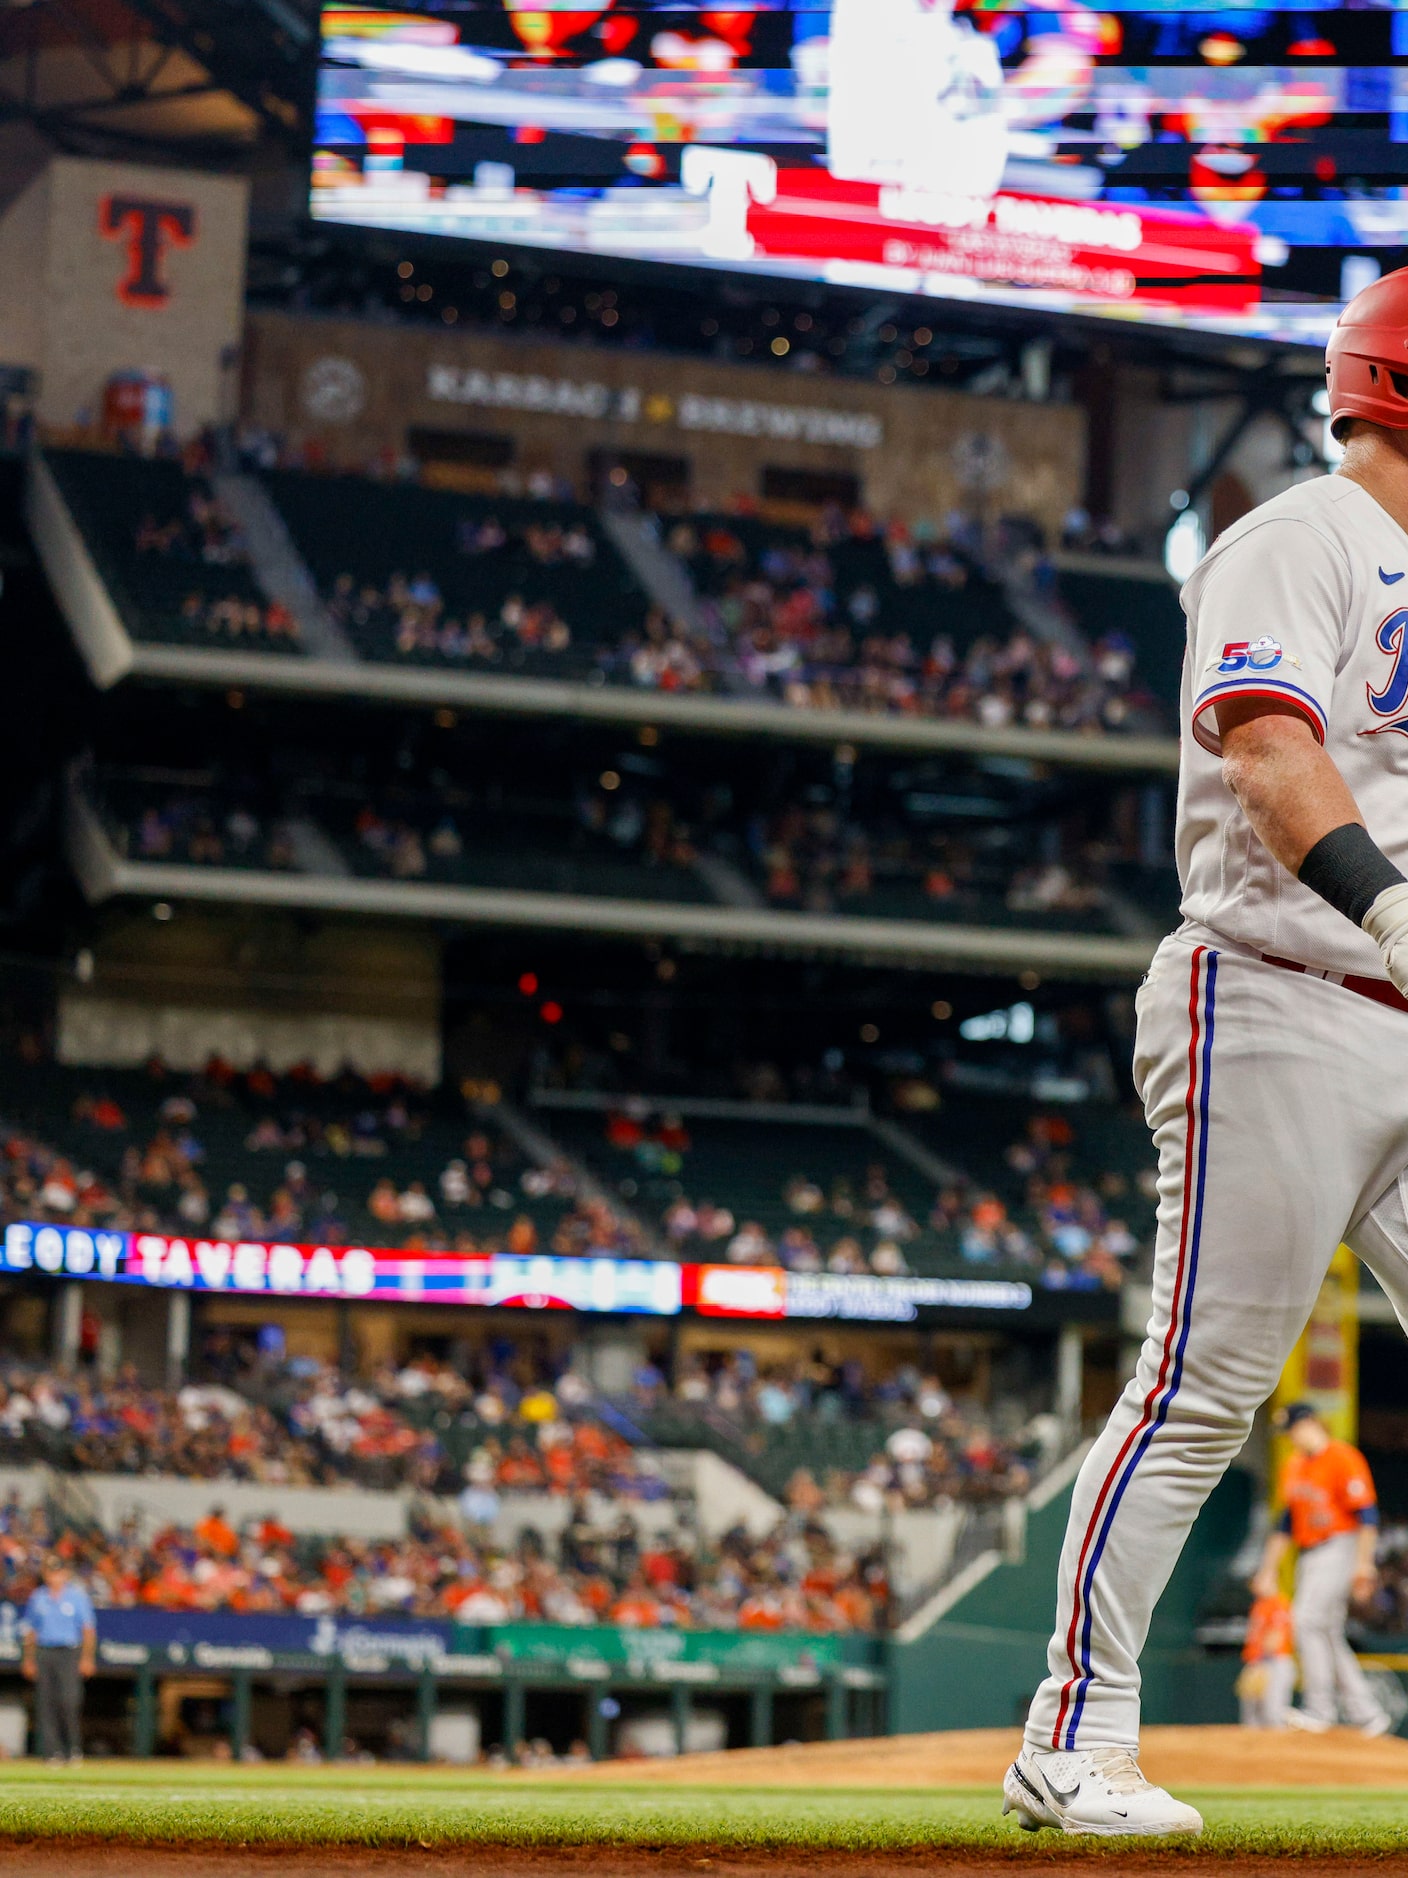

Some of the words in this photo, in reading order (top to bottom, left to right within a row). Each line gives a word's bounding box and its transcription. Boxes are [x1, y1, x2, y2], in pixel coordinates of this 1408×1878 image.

[97, 191, 198, 309] T
[1217, 640, 1283, 673] 50
[0, 1223, 123, 1282] EODY
[136, 1233, 376, 1296] TAVERAS
